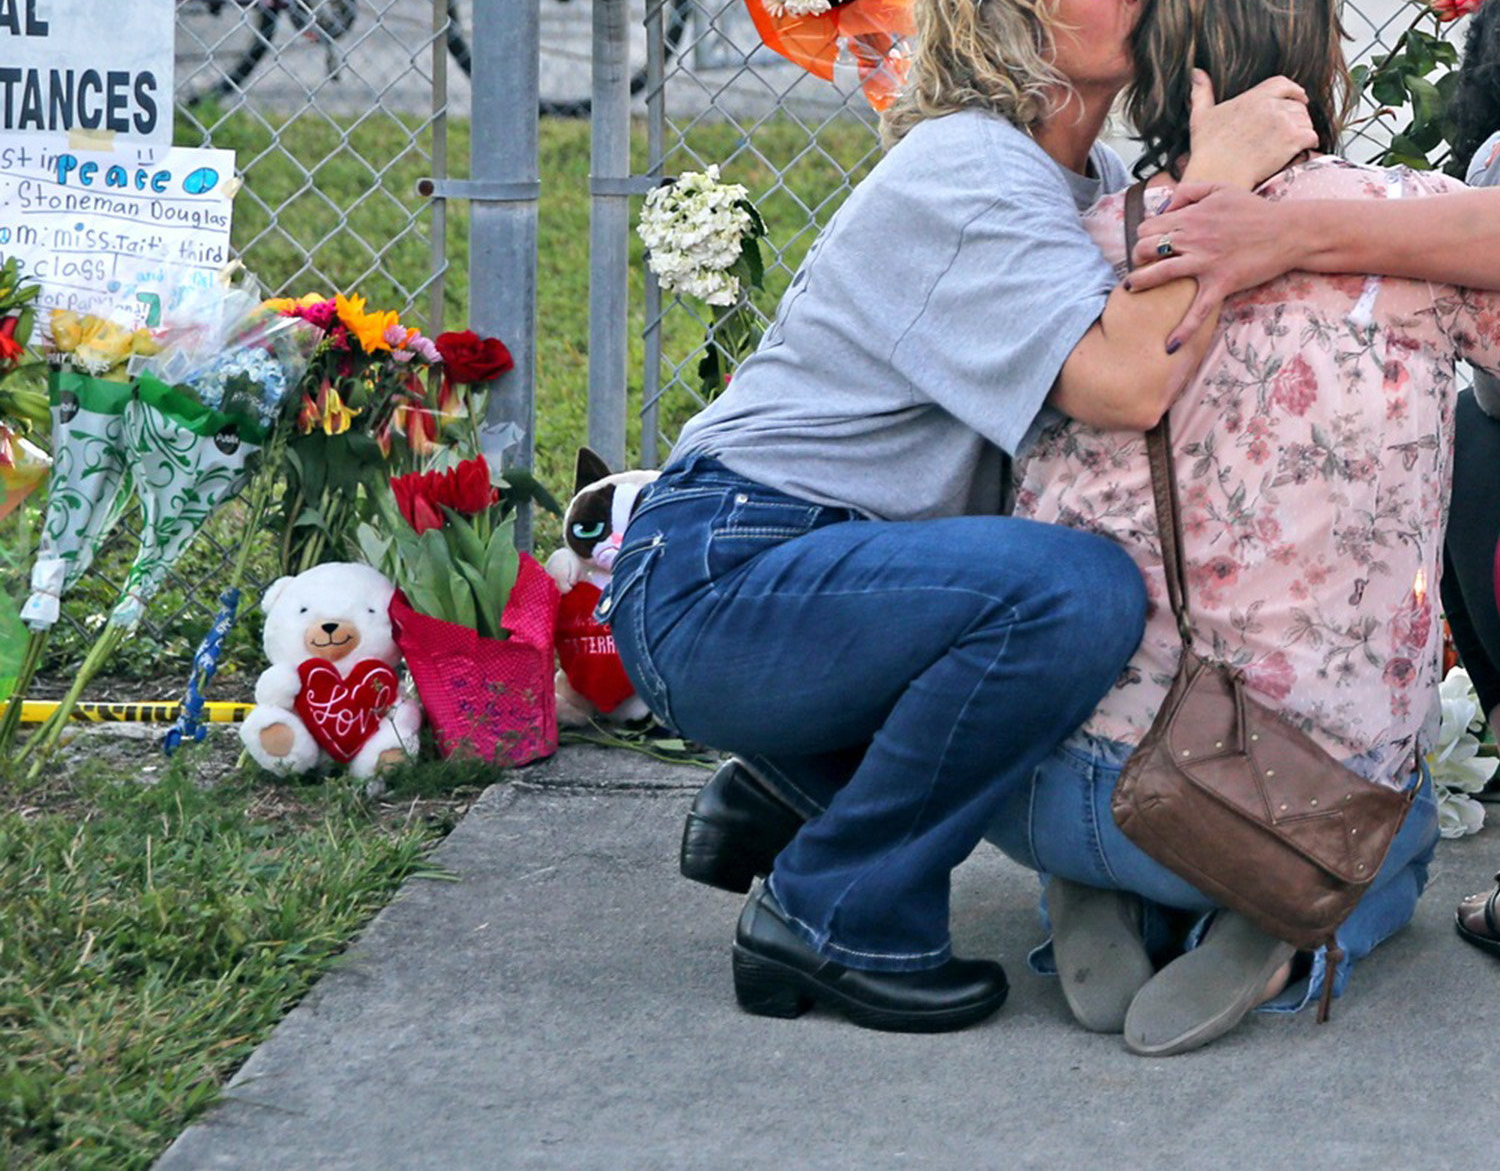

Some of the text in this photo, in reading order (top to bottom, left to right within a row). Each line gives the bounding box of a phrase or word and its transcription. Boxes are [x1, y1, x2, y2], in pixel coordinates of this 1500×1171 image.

[0, 67, 158, 135] TANCES
[1, 147, 33, 169] st
[18, 180, 228, 228] Stoneman Douglas
[179, 239, 223, 264] third
[306, 684, 391, 737] Love
